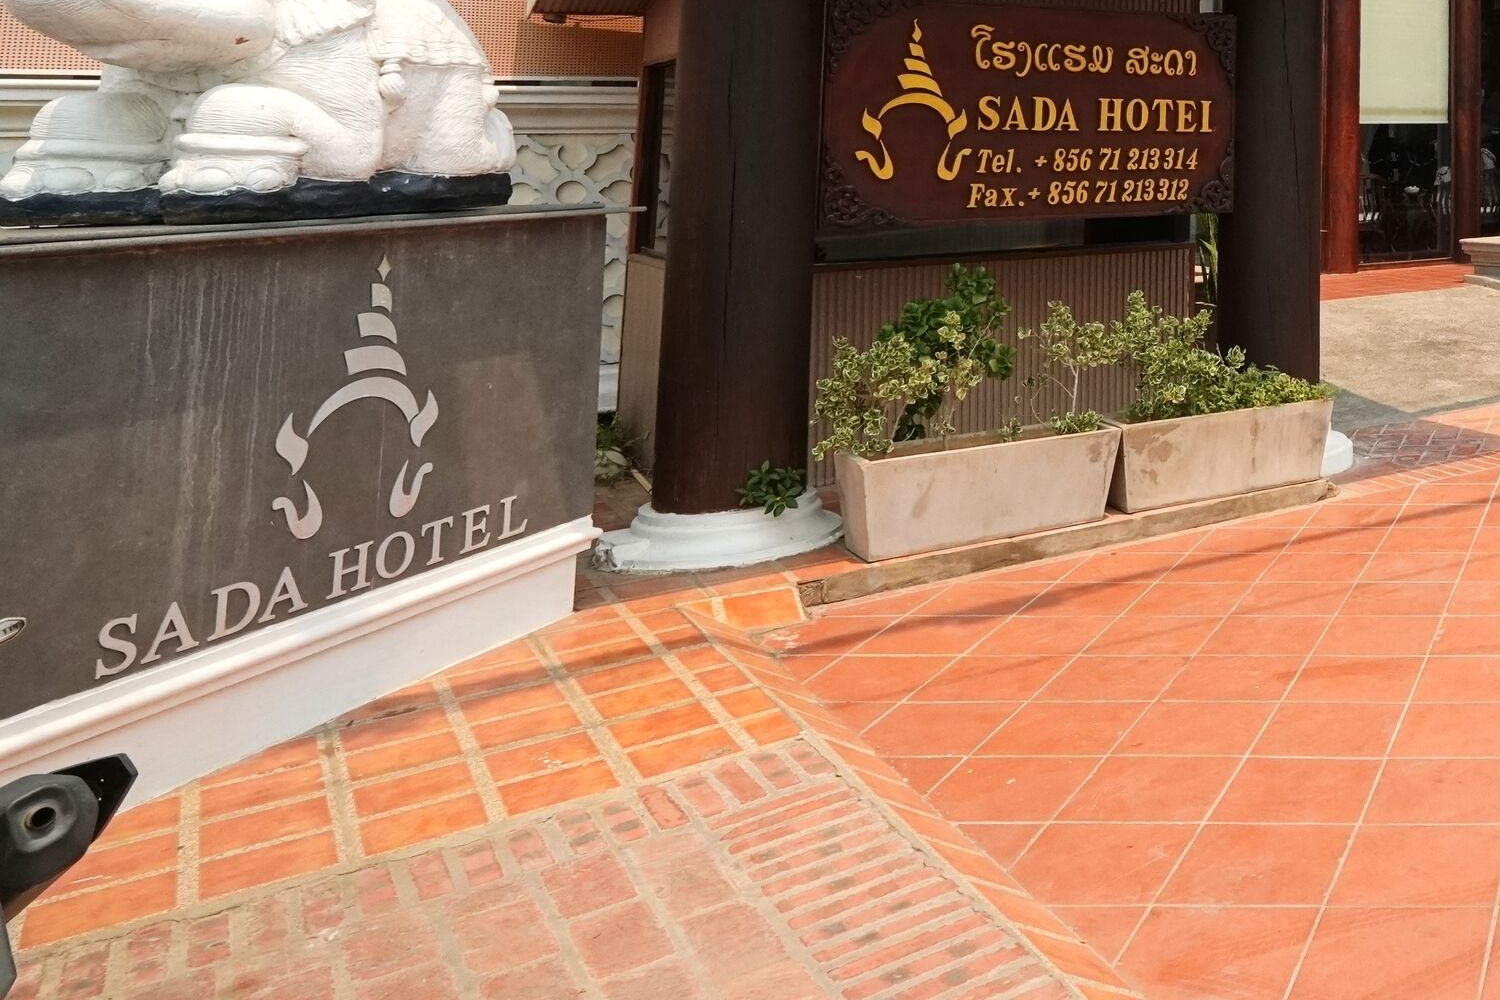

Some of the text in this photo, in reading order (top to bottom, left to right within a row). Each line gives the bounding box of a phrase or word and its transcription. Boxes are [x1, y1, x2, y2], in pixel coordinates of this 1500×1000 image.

[977, 96, 1080, 131] SADA
[976, 149, 1022, 174] Tel.
[1053, 148, 1093, 172] 856
[1100, 147, 1121, 170] 71
[966, 183, 1025, 209] Fax.
[1047, 180, 1090, 205] 856
[1094, 180, 1118, 203] 71
[94, 495, 529, 680] SADA HOTEL
